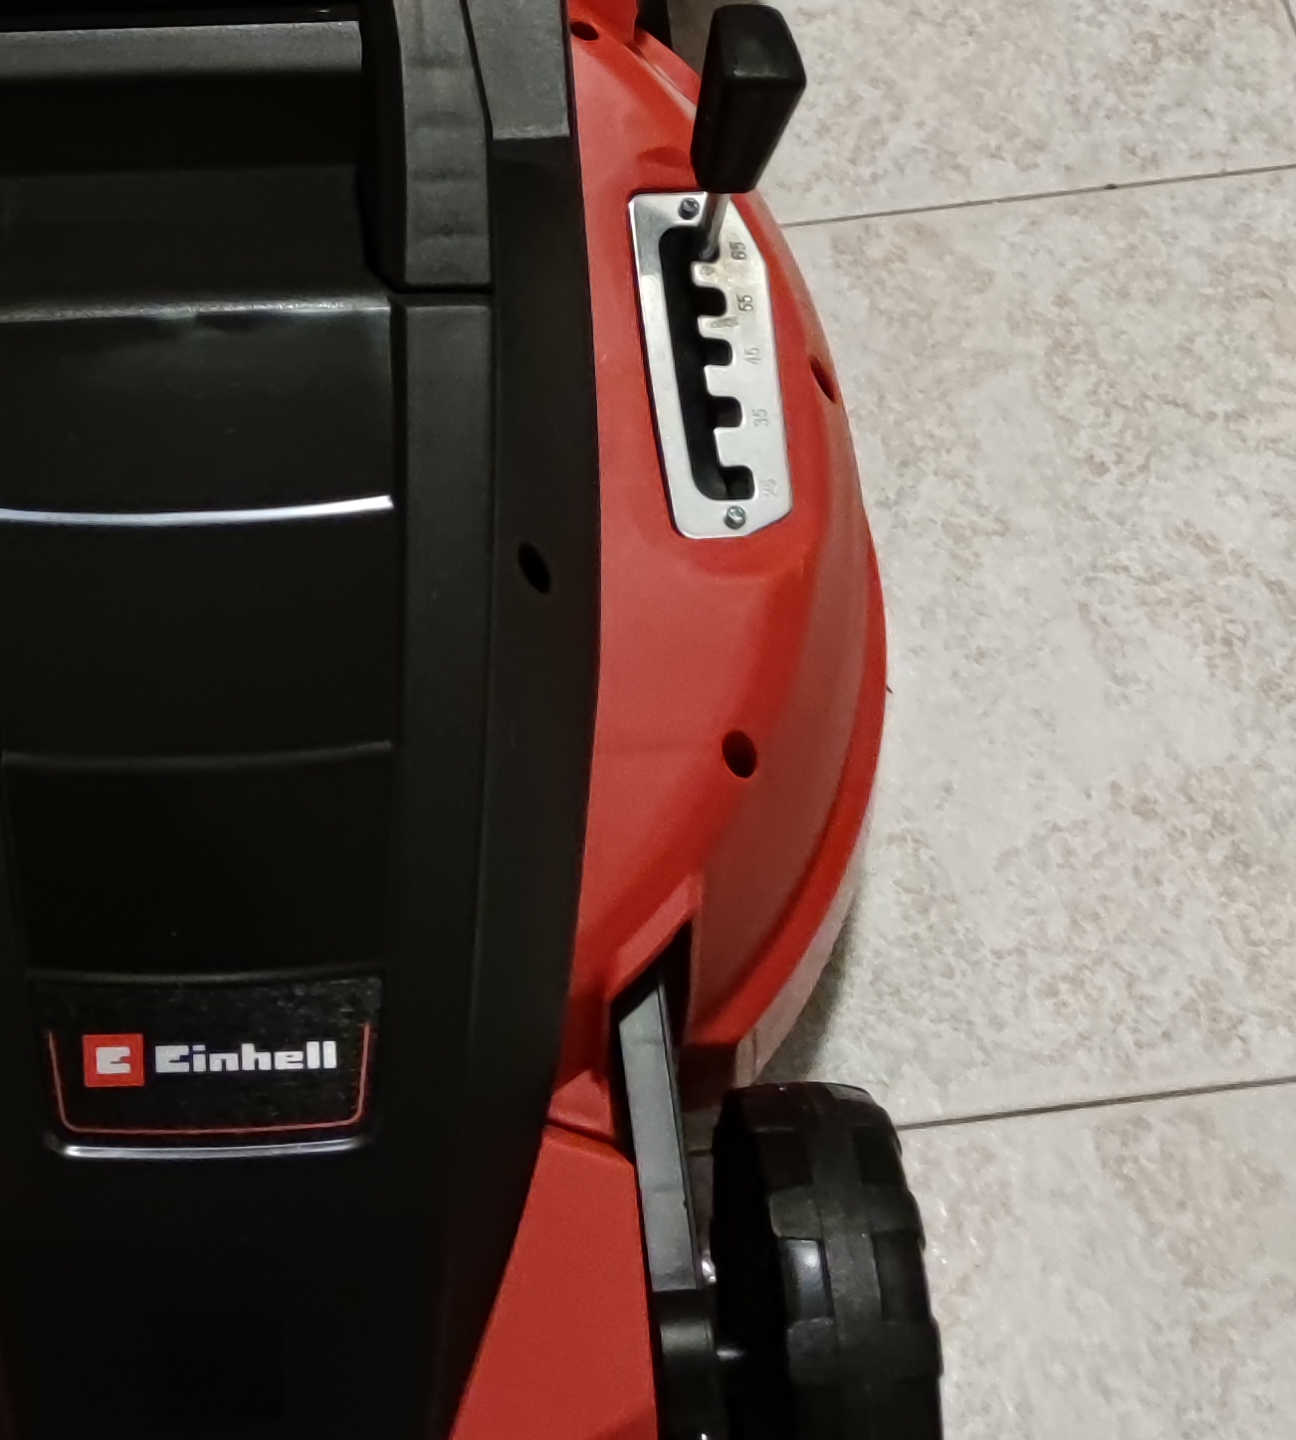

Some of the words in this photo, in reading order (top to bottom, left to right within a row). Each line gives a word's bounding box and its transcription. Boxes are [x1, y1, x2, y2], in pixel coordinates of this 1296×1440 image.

[729, 241, 747, 260] 65
[751, 408, 769, 427] 35
[155, 1040, 337, 1073] Einhell
